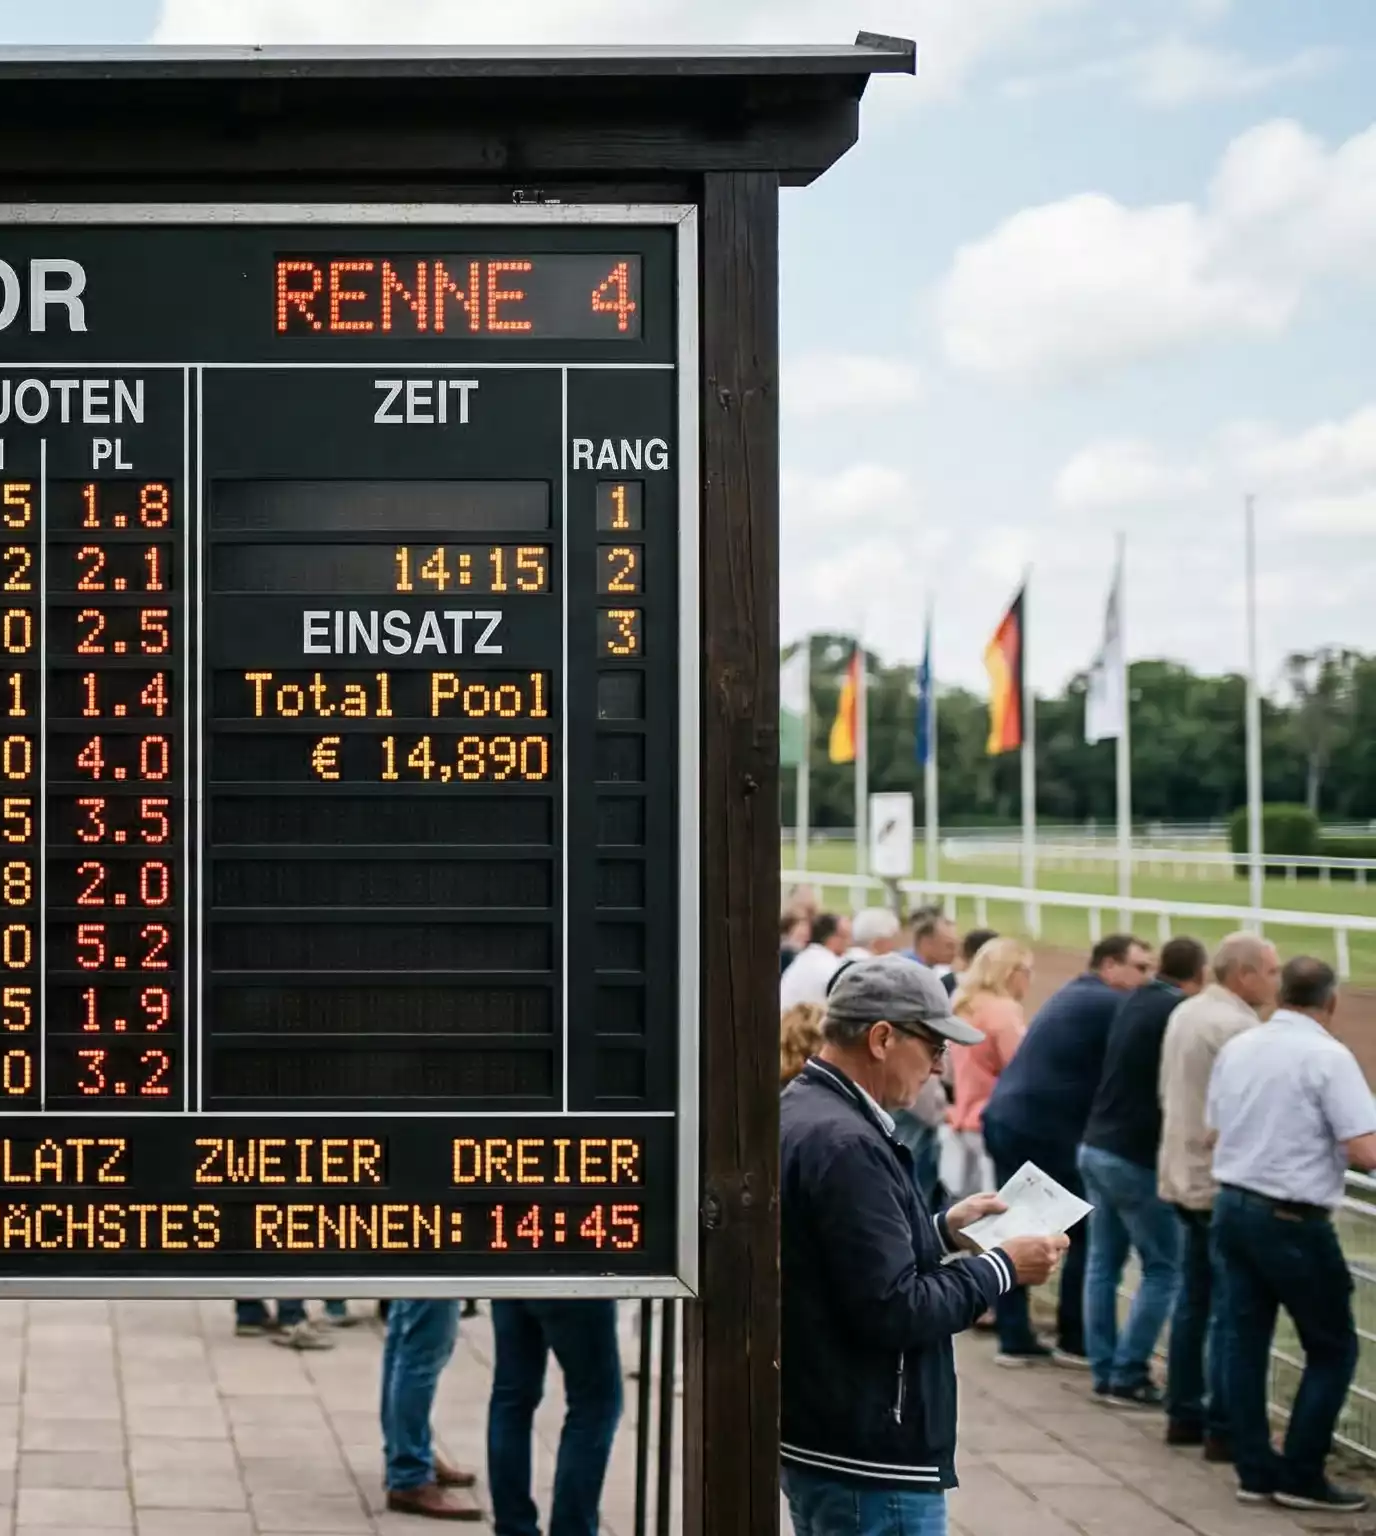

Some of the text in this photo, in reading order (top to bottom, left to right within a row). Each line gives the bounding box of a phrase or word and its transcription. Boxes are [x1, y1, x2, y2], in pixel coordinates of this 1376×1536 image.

[277, 260, 636, 333] RENNE 4
[374, 380, 478, 423] ZEIT
[93, 439, 132, 469] PL
[573, 438, 668, 470] RANG
[83, 484, 168, 527] 1.8
[611, 486, 629, 529] 1
[78, 547, 162, 590] 2.1
[396, 547, 544, 591] 14:15
[608, 548, 636, 592] 2
[78, 610, 168, 653] 2.5
[304, 610, 502, 654] EINSATZ
[608, 610, 635, 654] 3
[83, 673, 168, 716] 1.4
[245, 673, 547, 717] Total Pool
[78, 736, 168, 779] 4.0
[312, 736, 548, 782] € 14,890
[78, 798, 168, 843] 3.5
[77, 862, 168, 905] 2.0
[78, 924, 169, 968] 5.2
[83, 988, 169, 1031] 1.9
[78, 1050, 169, 1094] 3.2
[195, 1139, 380, 1182] ZWEIER
[454, 1139, 638, 1183] DREIER
[256, 1205, 461, 1248] RENNEN:
[491, 1205, 639, 1248] 14:45
